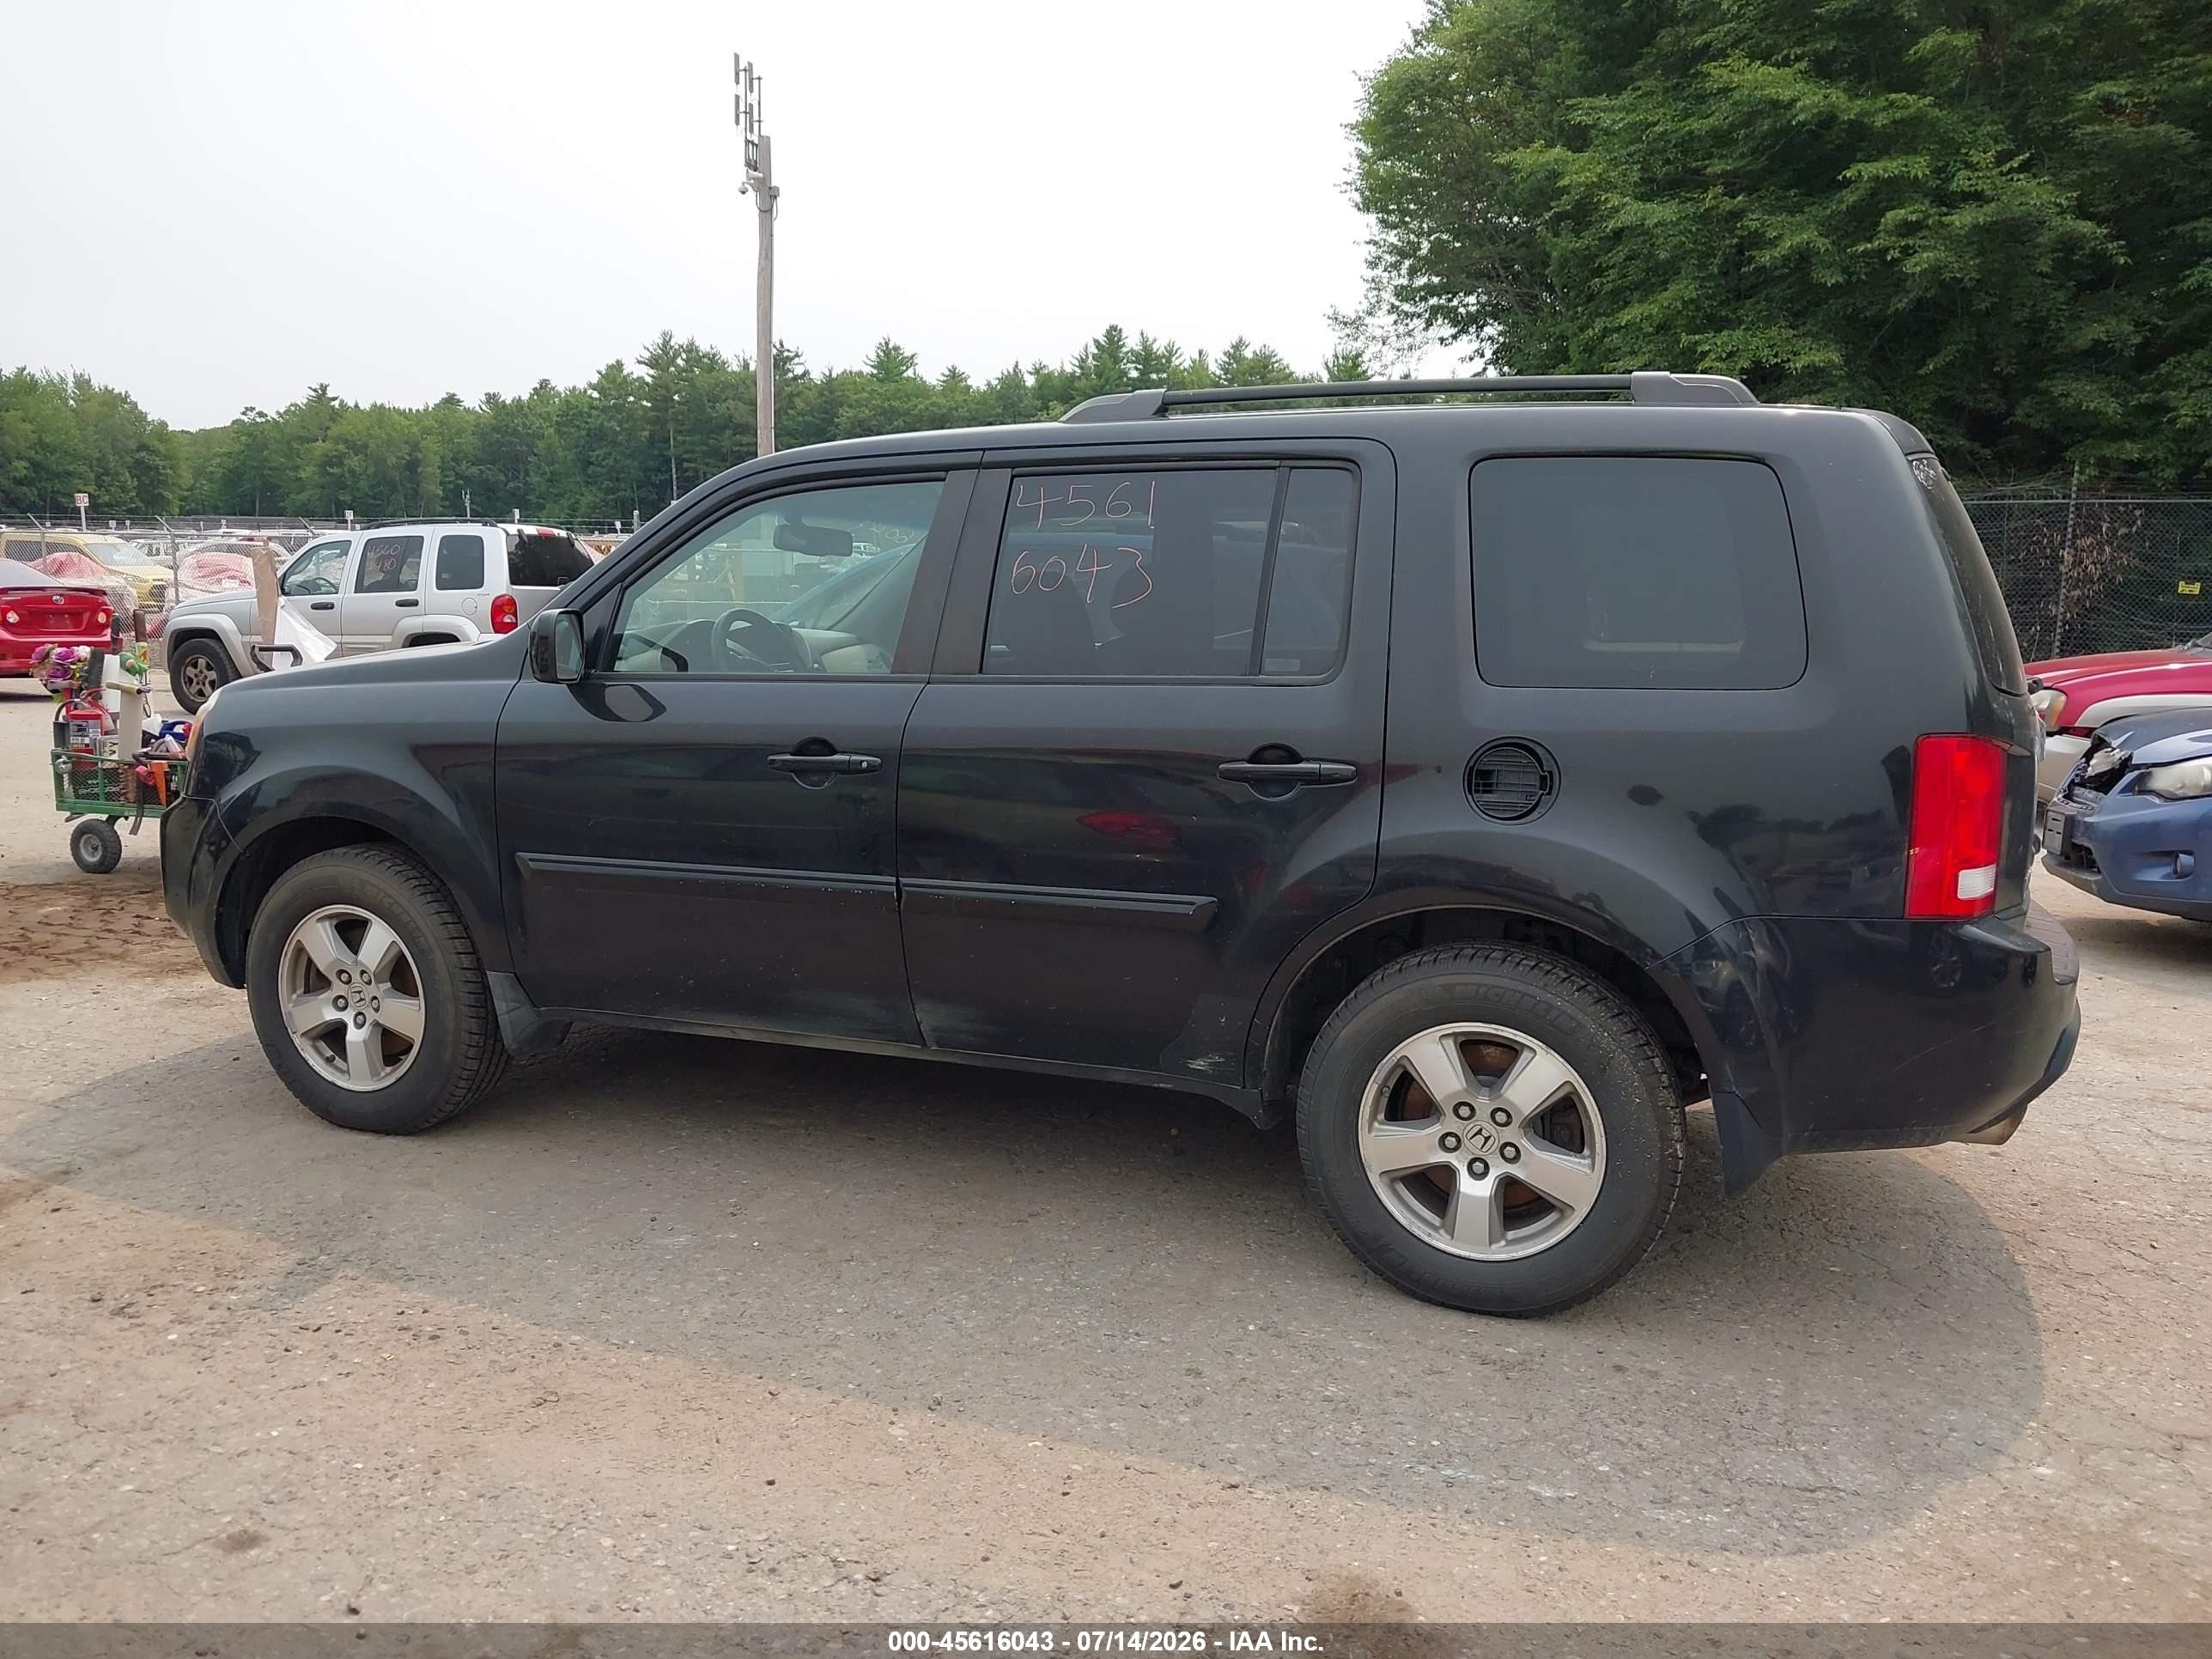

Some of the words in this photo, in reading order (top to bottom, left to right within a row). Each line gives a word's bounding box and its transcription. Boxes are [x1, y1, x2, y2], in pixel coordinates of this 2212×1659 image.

[76, 495, 88, 505] BC
[1017, 481, 1155, 529] 4561
[1012, 544, 1152, 609] 6043
